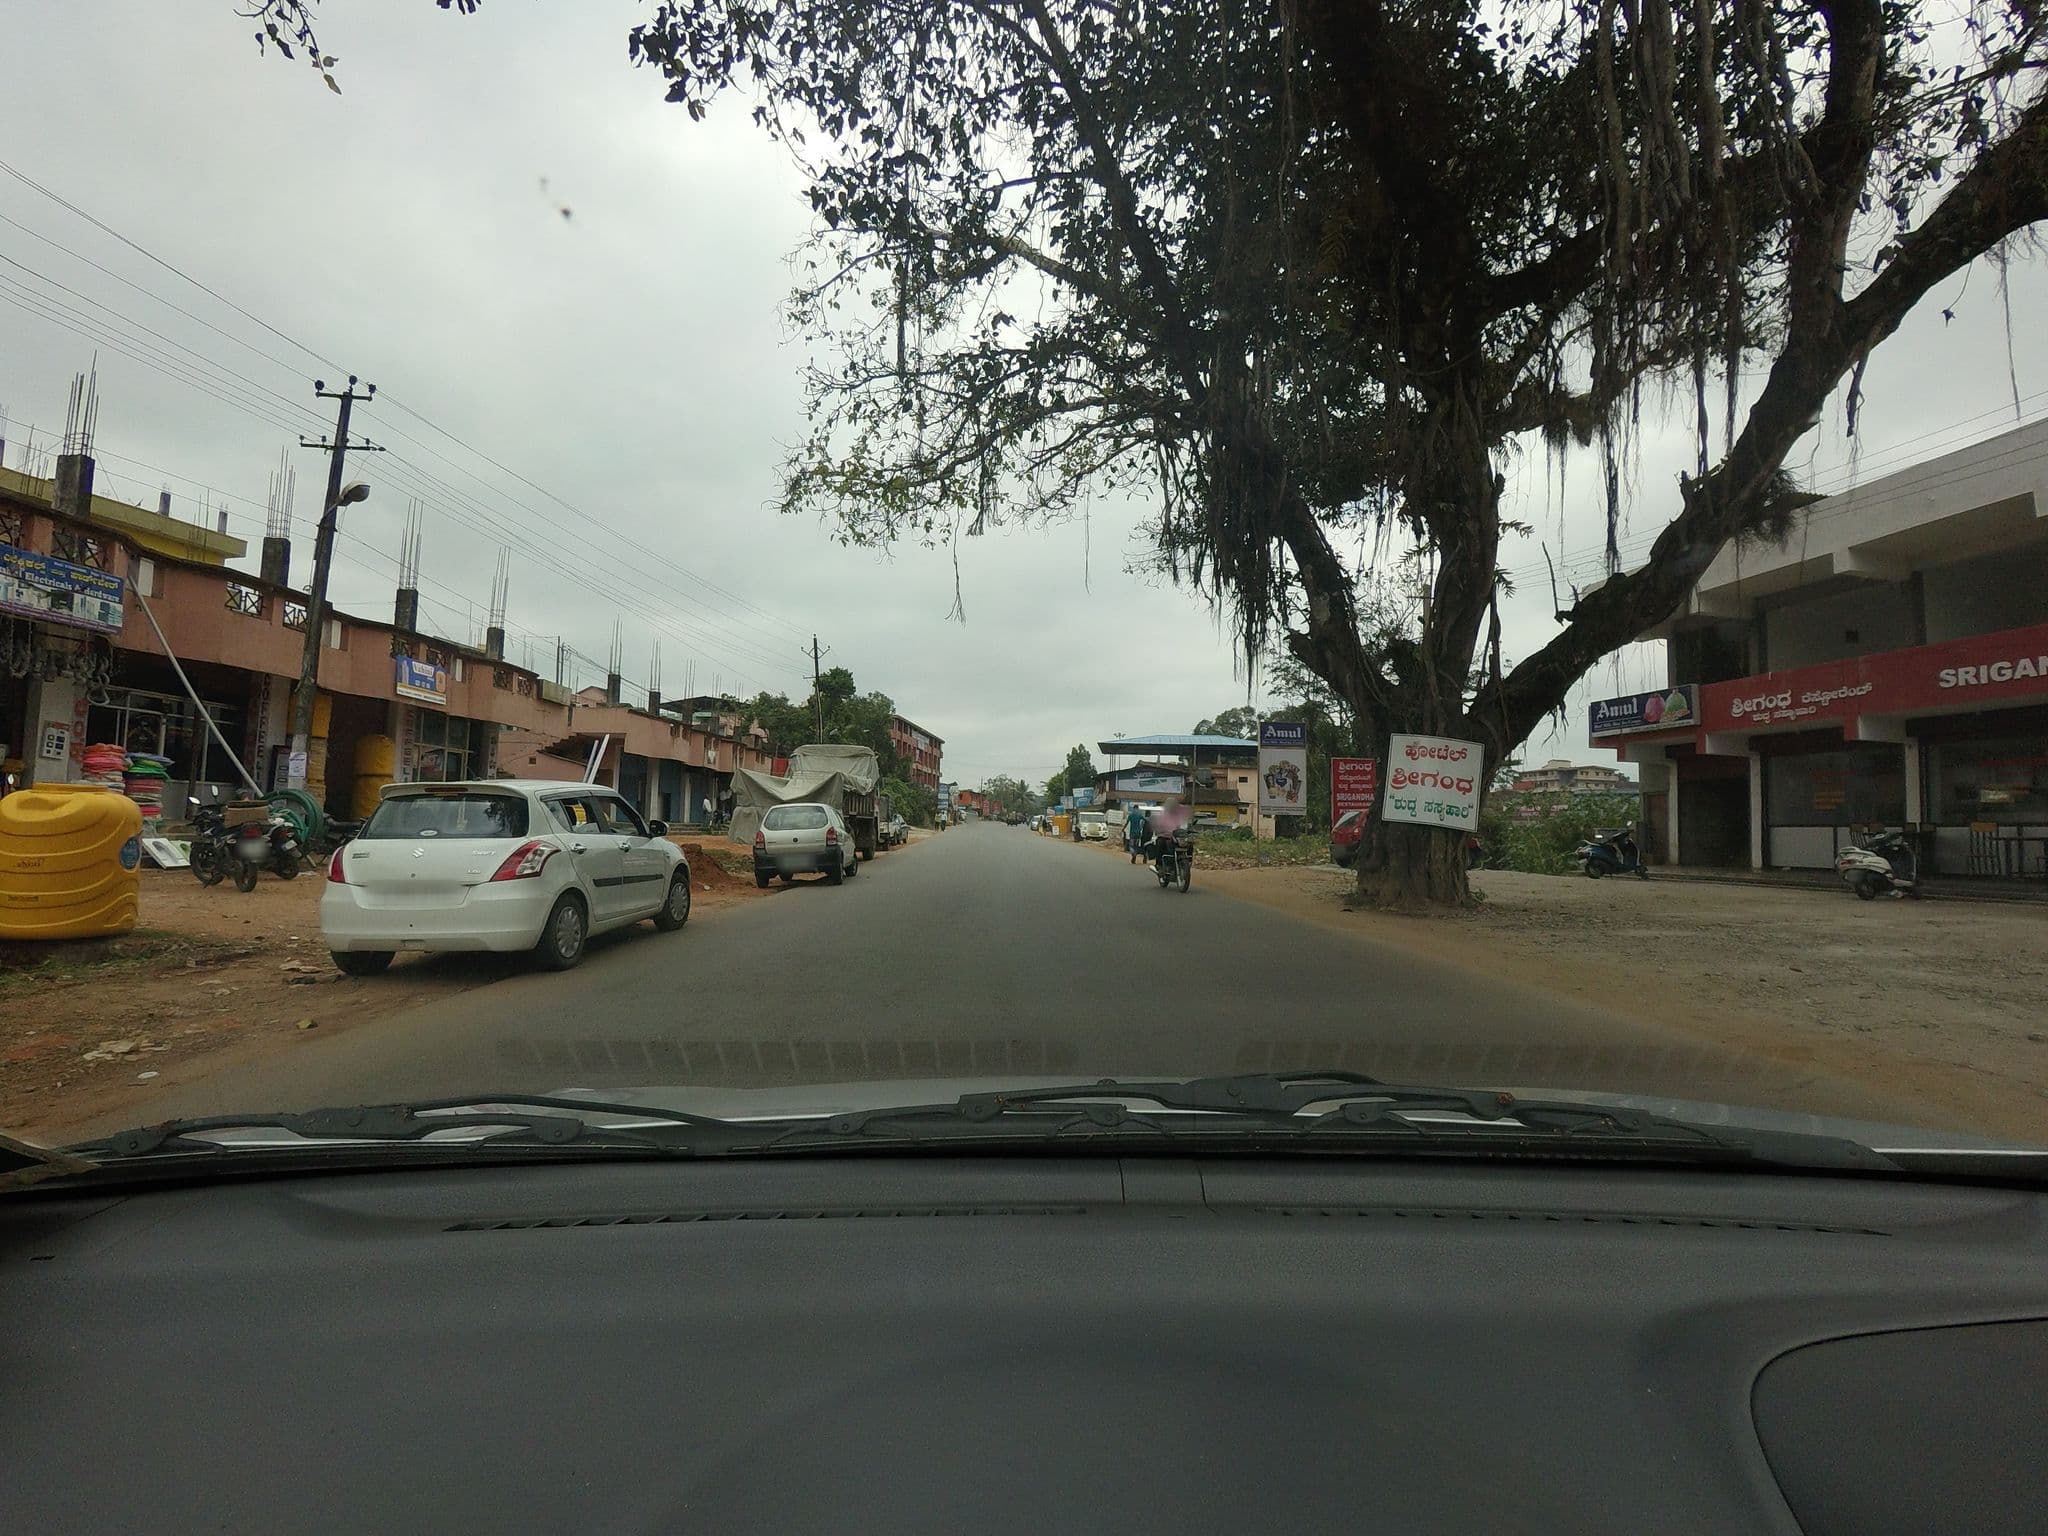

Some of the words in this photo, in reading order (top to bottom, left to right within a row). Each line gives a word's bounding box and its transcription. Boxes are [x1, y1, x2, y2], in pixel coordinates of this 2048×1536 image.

[1596, 697, 1638, 721] Amul
[1731, 689, 1791, 717] ಶ್ರೀಗಂಧ
[1264, 725, 1301, 738] Amul
[1405, 744, 1467, 761] ಹೋಟೆಲ್
[1337, 762, 1372, 774] ಶ್ರೀಗಂಧ
[1391, 767, 1474, 795] ಶ್ರೀಗಂಧ
[1336, 793, 1375, 801] SRIGANDHA
